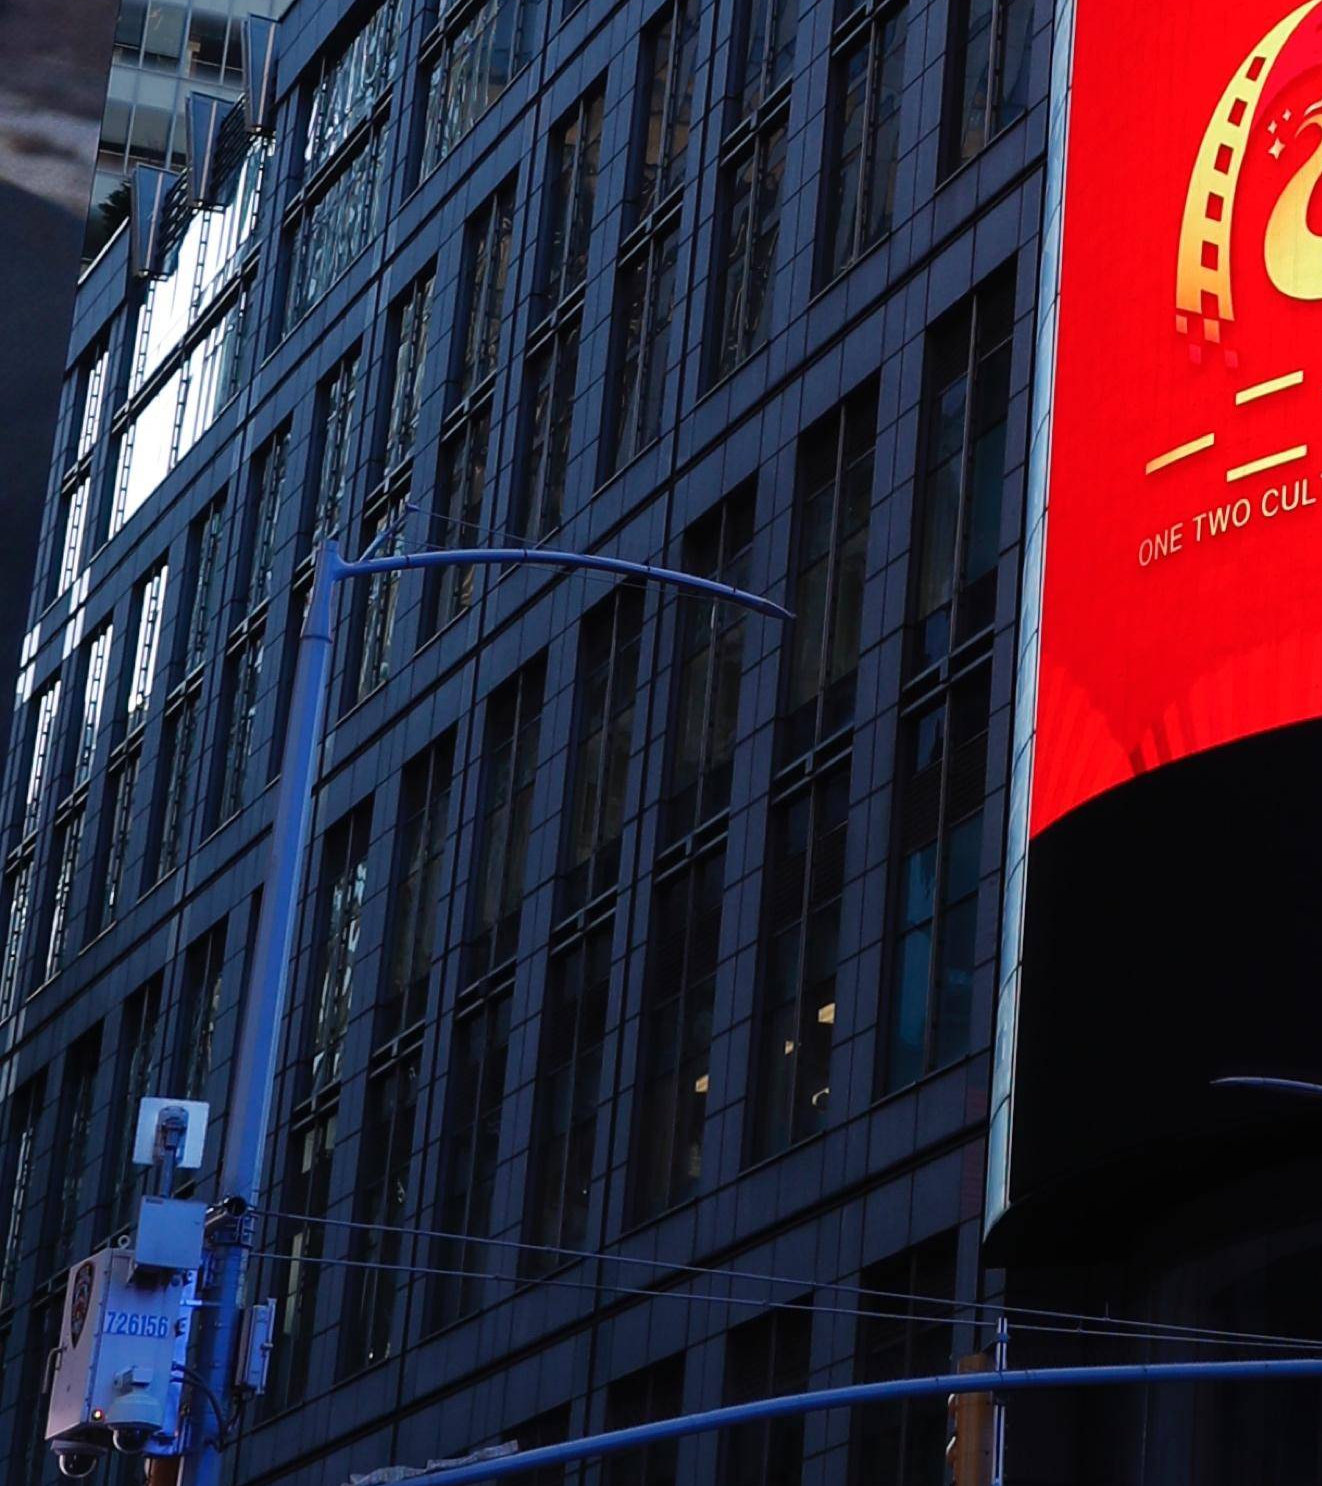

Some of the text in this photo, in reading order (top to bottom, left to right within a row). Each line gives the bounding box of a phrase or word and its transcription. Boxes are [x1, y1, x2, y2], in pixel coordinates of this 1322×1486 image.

[1138, 522, 1184, 567] ONE
[1192, 497, 1251, 543] TWO
[107, 1312, 169, 1338] 726156
